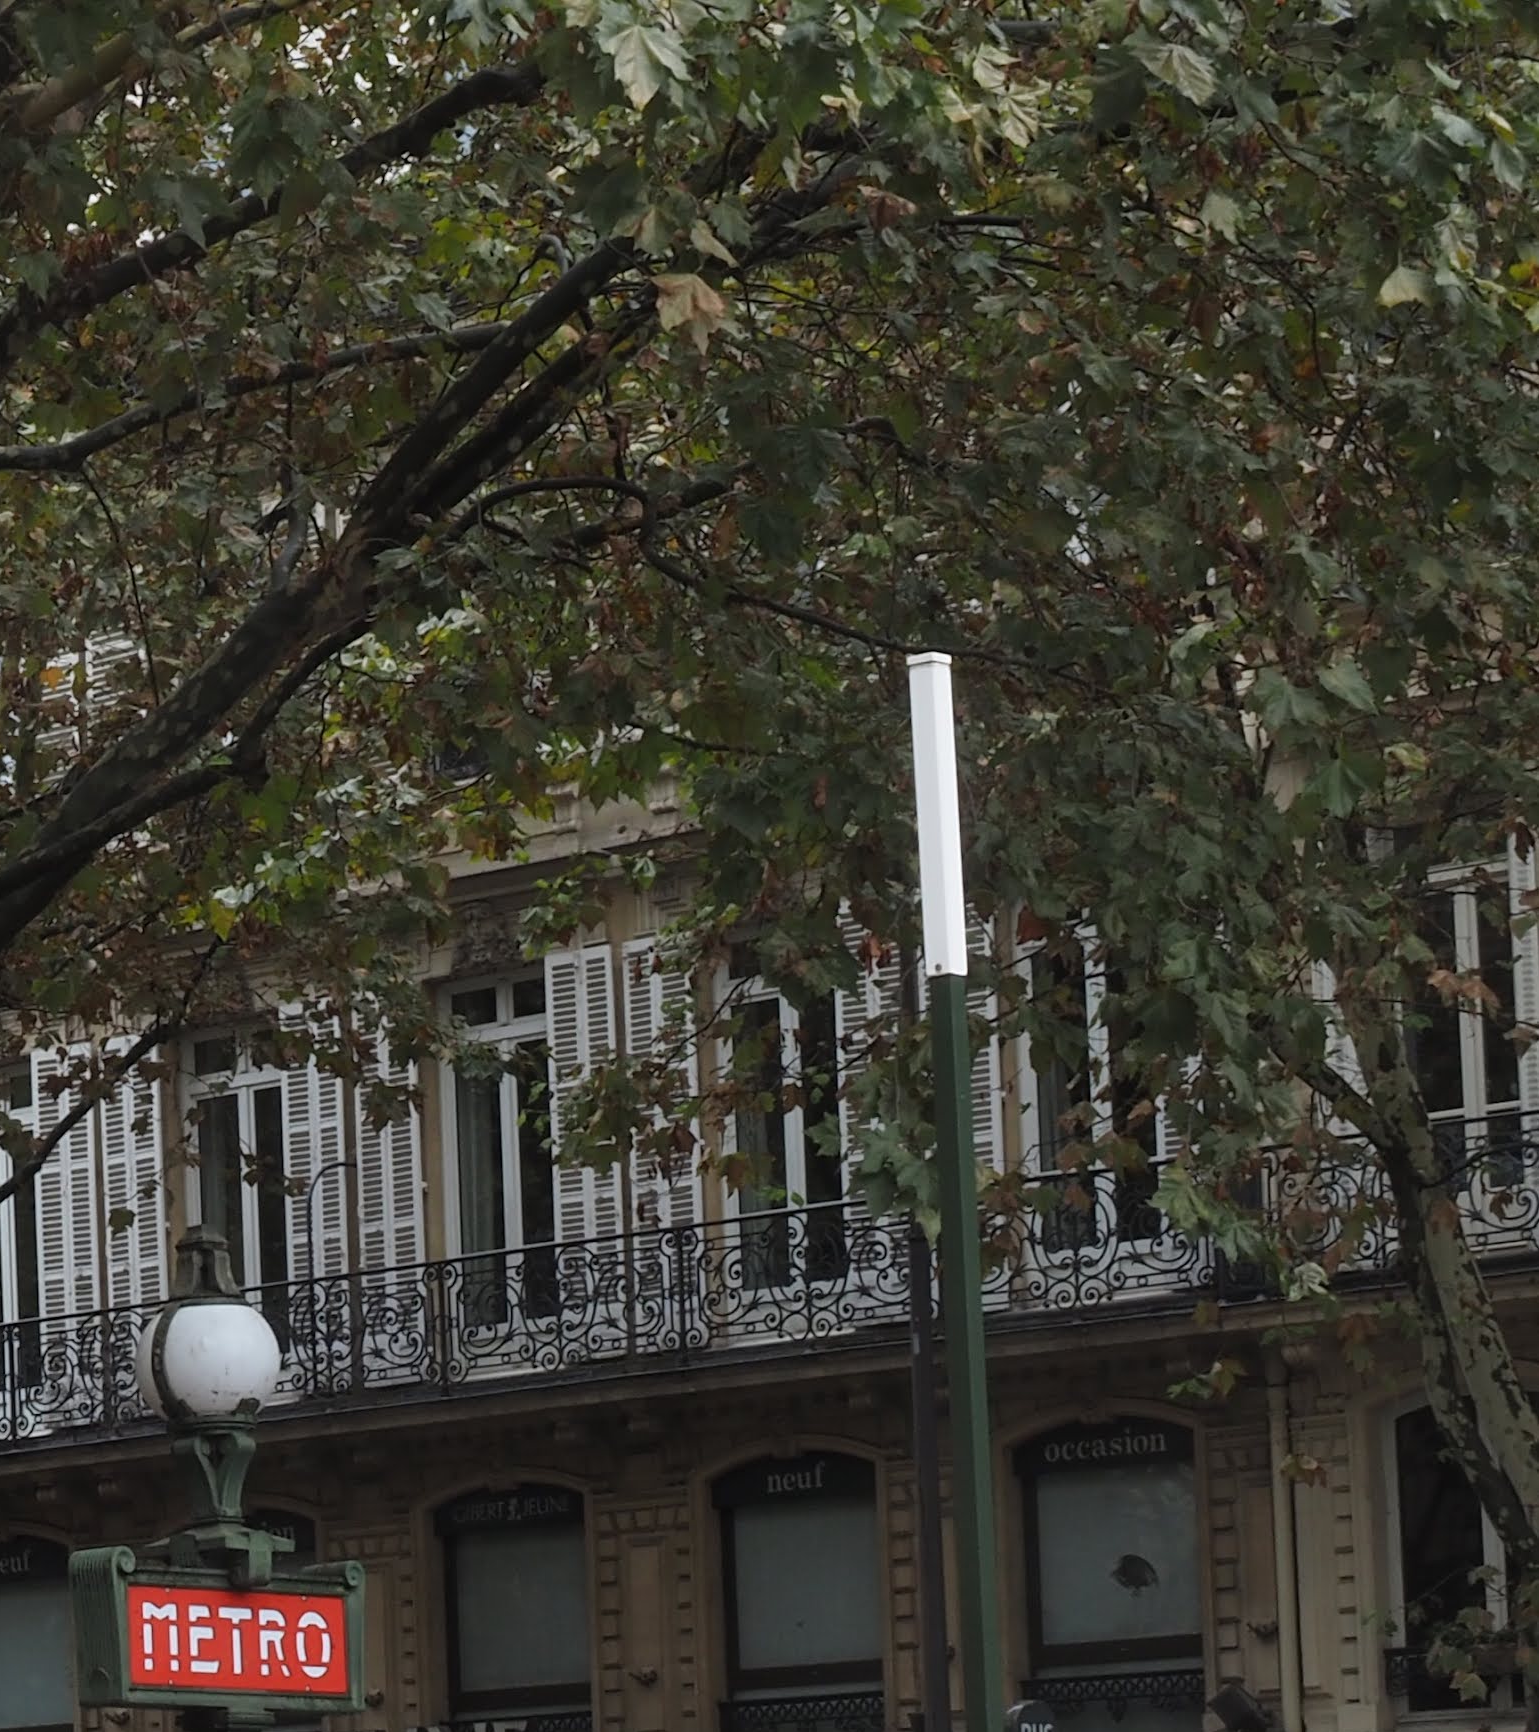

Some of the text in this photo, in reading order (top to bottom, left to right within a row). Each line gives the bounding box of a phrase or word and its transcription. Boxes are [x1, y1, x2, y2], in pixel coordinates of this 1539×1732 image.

[1044, 1427, 1169, 1463] occasion
[767, 1460, 826, 1493] neuf
[141, 1601, 331, 1679] METRO
